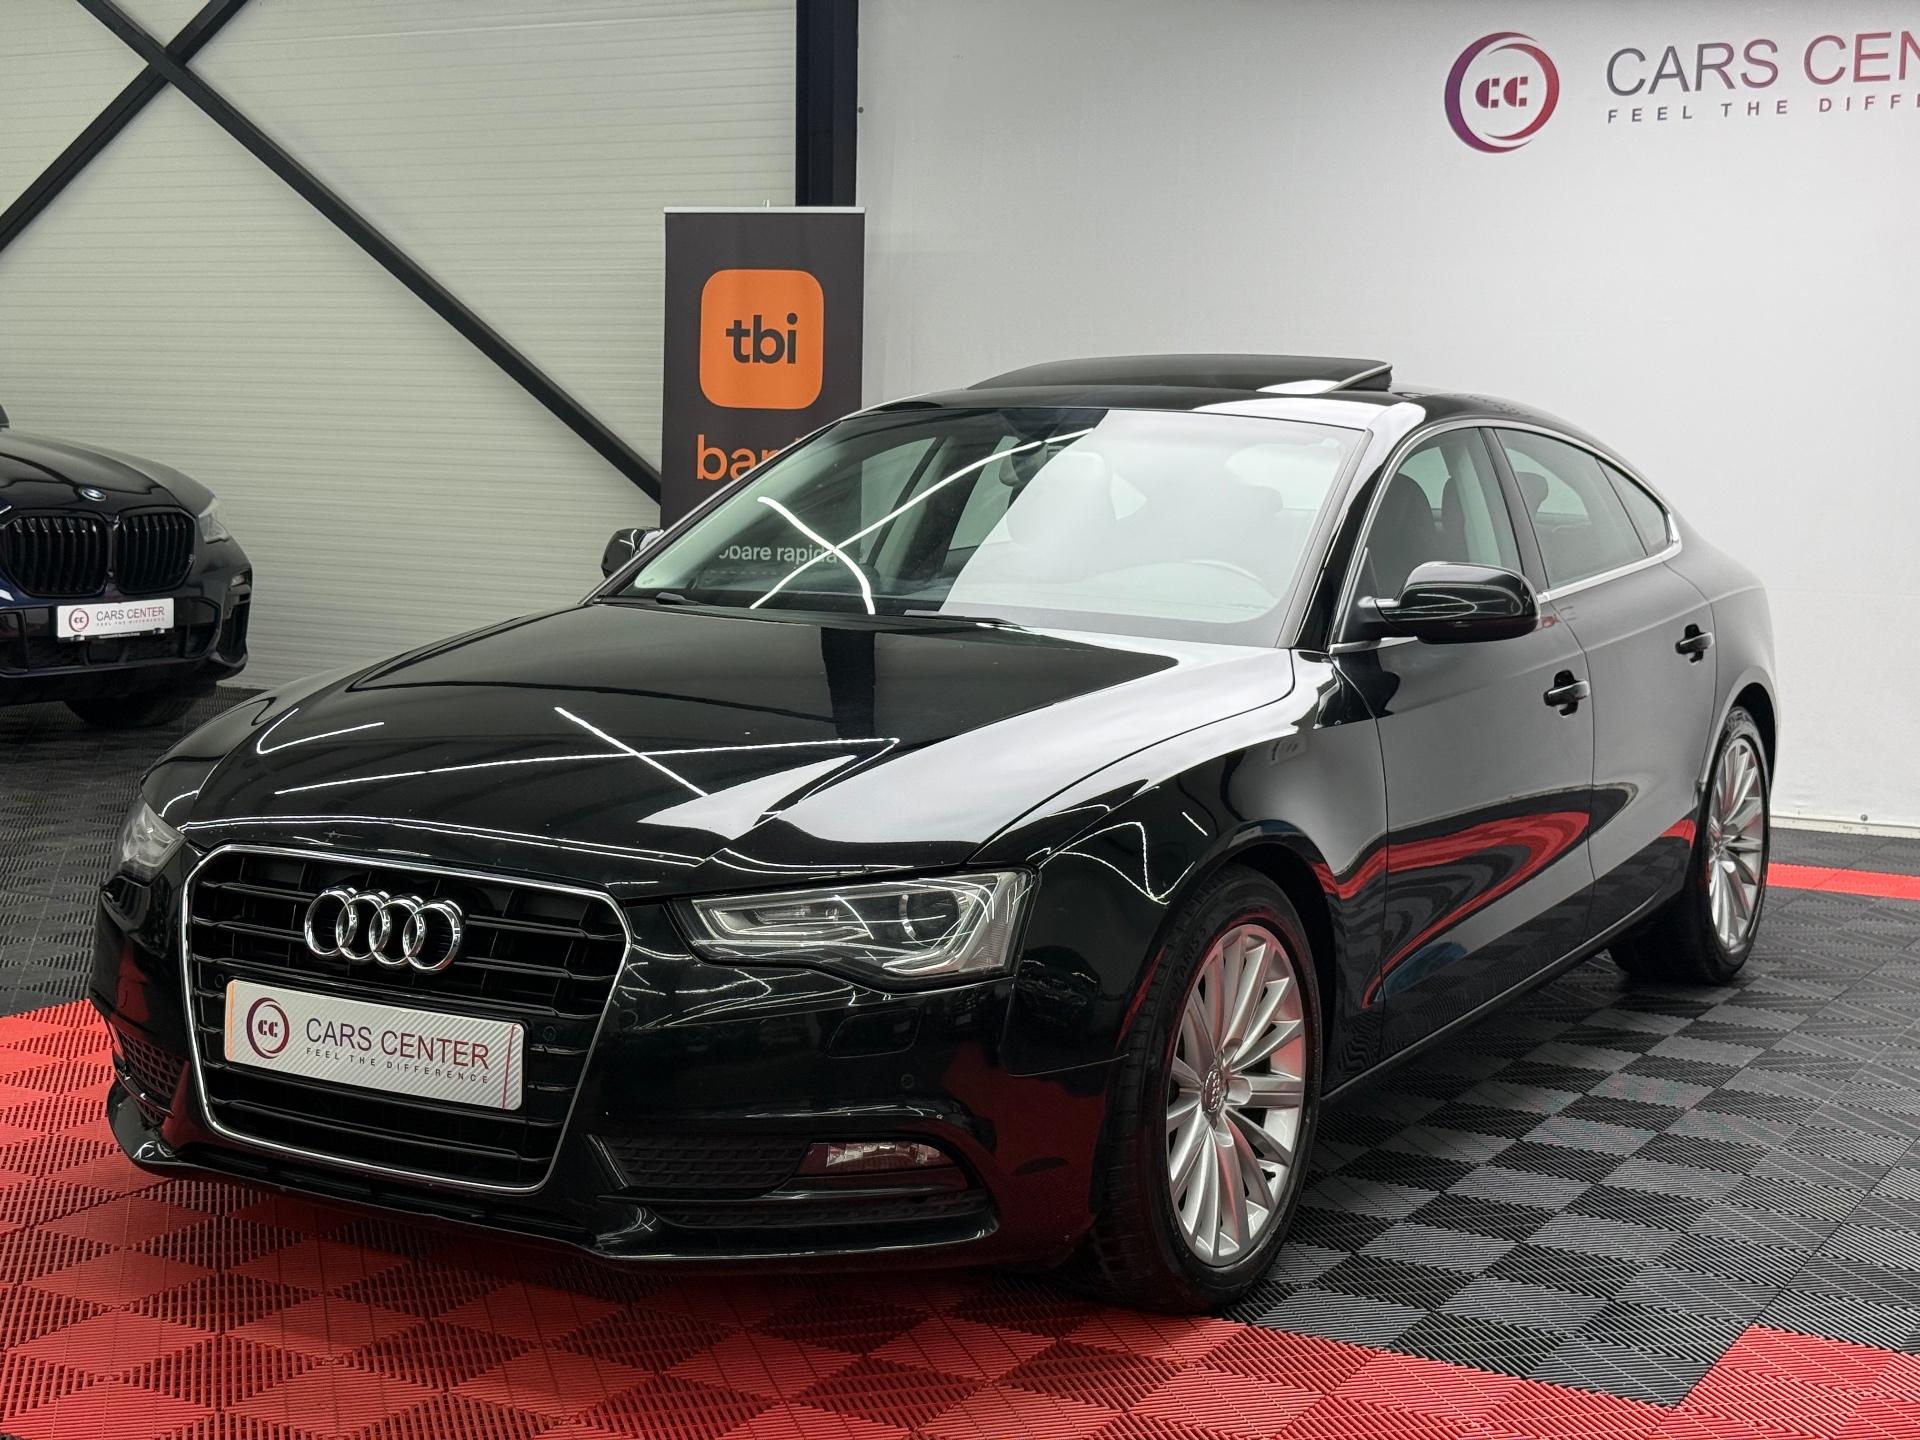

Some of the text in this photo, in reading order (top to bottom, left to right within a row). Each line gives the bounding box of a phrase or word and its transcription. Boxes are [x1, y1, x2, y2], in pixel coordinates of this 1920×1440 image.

[1606, 39, 1779, 97] CARS
[1608, 94, 1920, 124] FEEL THE DIFF
[726, 313, 798, 364] tbi
[96, 606, 165, 621] CARS CENTER
[306, 1017, 489, 1069] CARS CENTER
[306, 1047, 488, 1084] FEEL THE DIFFERENCE
